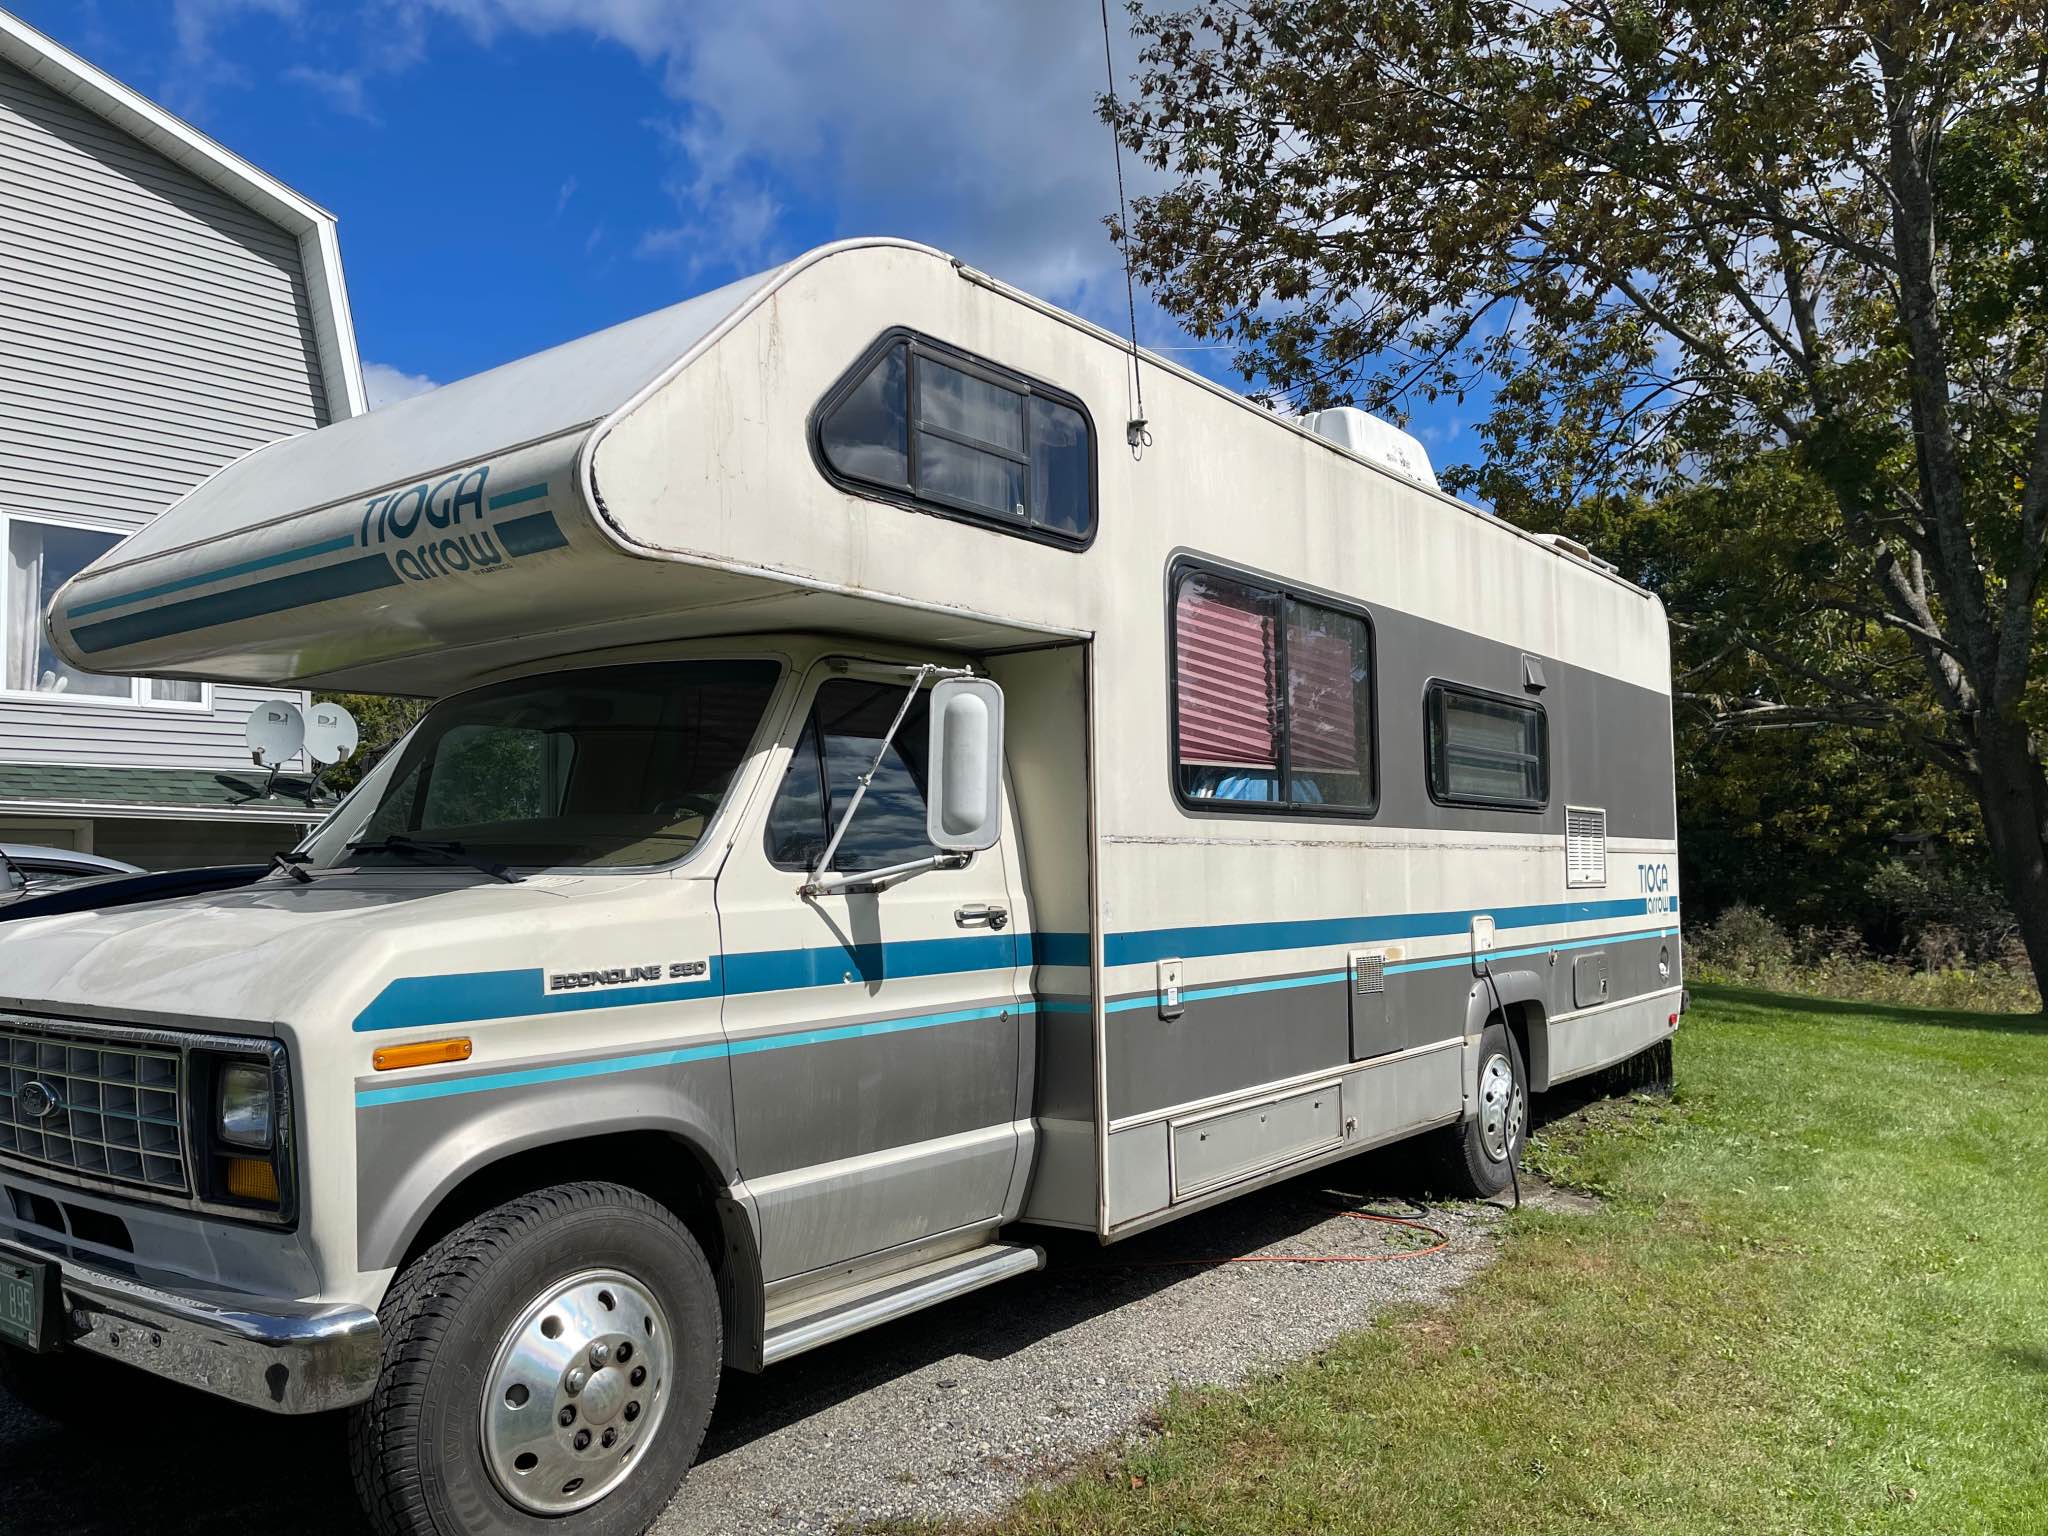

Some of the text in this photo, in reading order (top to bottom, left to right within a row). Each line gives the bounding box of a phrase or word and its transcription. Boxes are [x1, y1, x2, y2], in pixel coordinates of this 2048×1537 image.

[361, 466, 490, 547] TIOGA
[396, 531, 502, 581] arrow
[1638, 863, 1669, 893] TIOGA
[1648, 896, 1669, 914] arrow
[550, 965, 661, 990] ECONOLINE
[9, 1283, 31, 1325] 895
